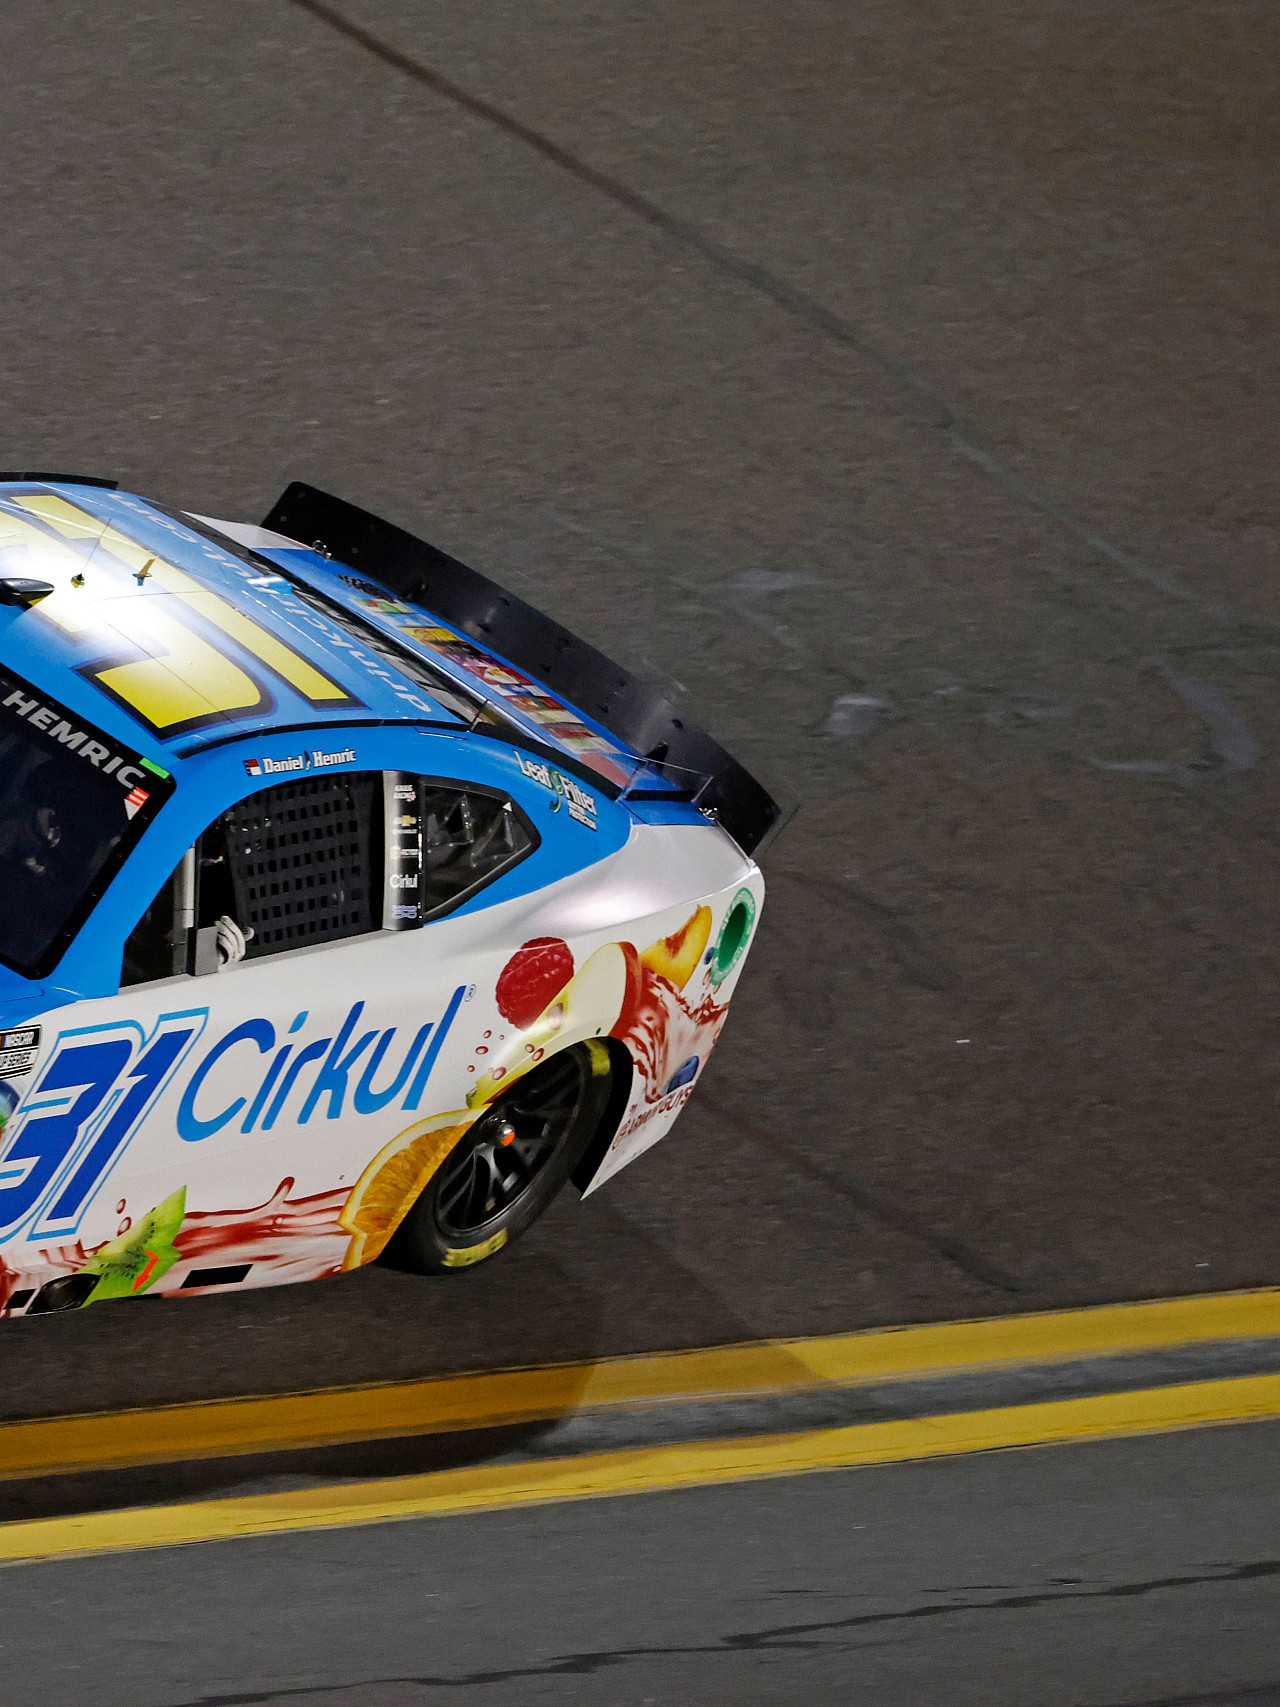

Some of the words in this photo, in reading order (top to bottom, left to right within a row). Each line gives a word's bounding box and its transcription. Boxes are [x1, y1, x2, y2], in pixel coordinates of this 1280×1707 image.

[0, 689, 147, 790] HEMRIC
[261, 754, 305, 774] Daniel
[311, 747, 357, 768] Hemric
[4, 1031, 35, 1048] NASCAR
[176, 984, 465, 1143] Cirkul
